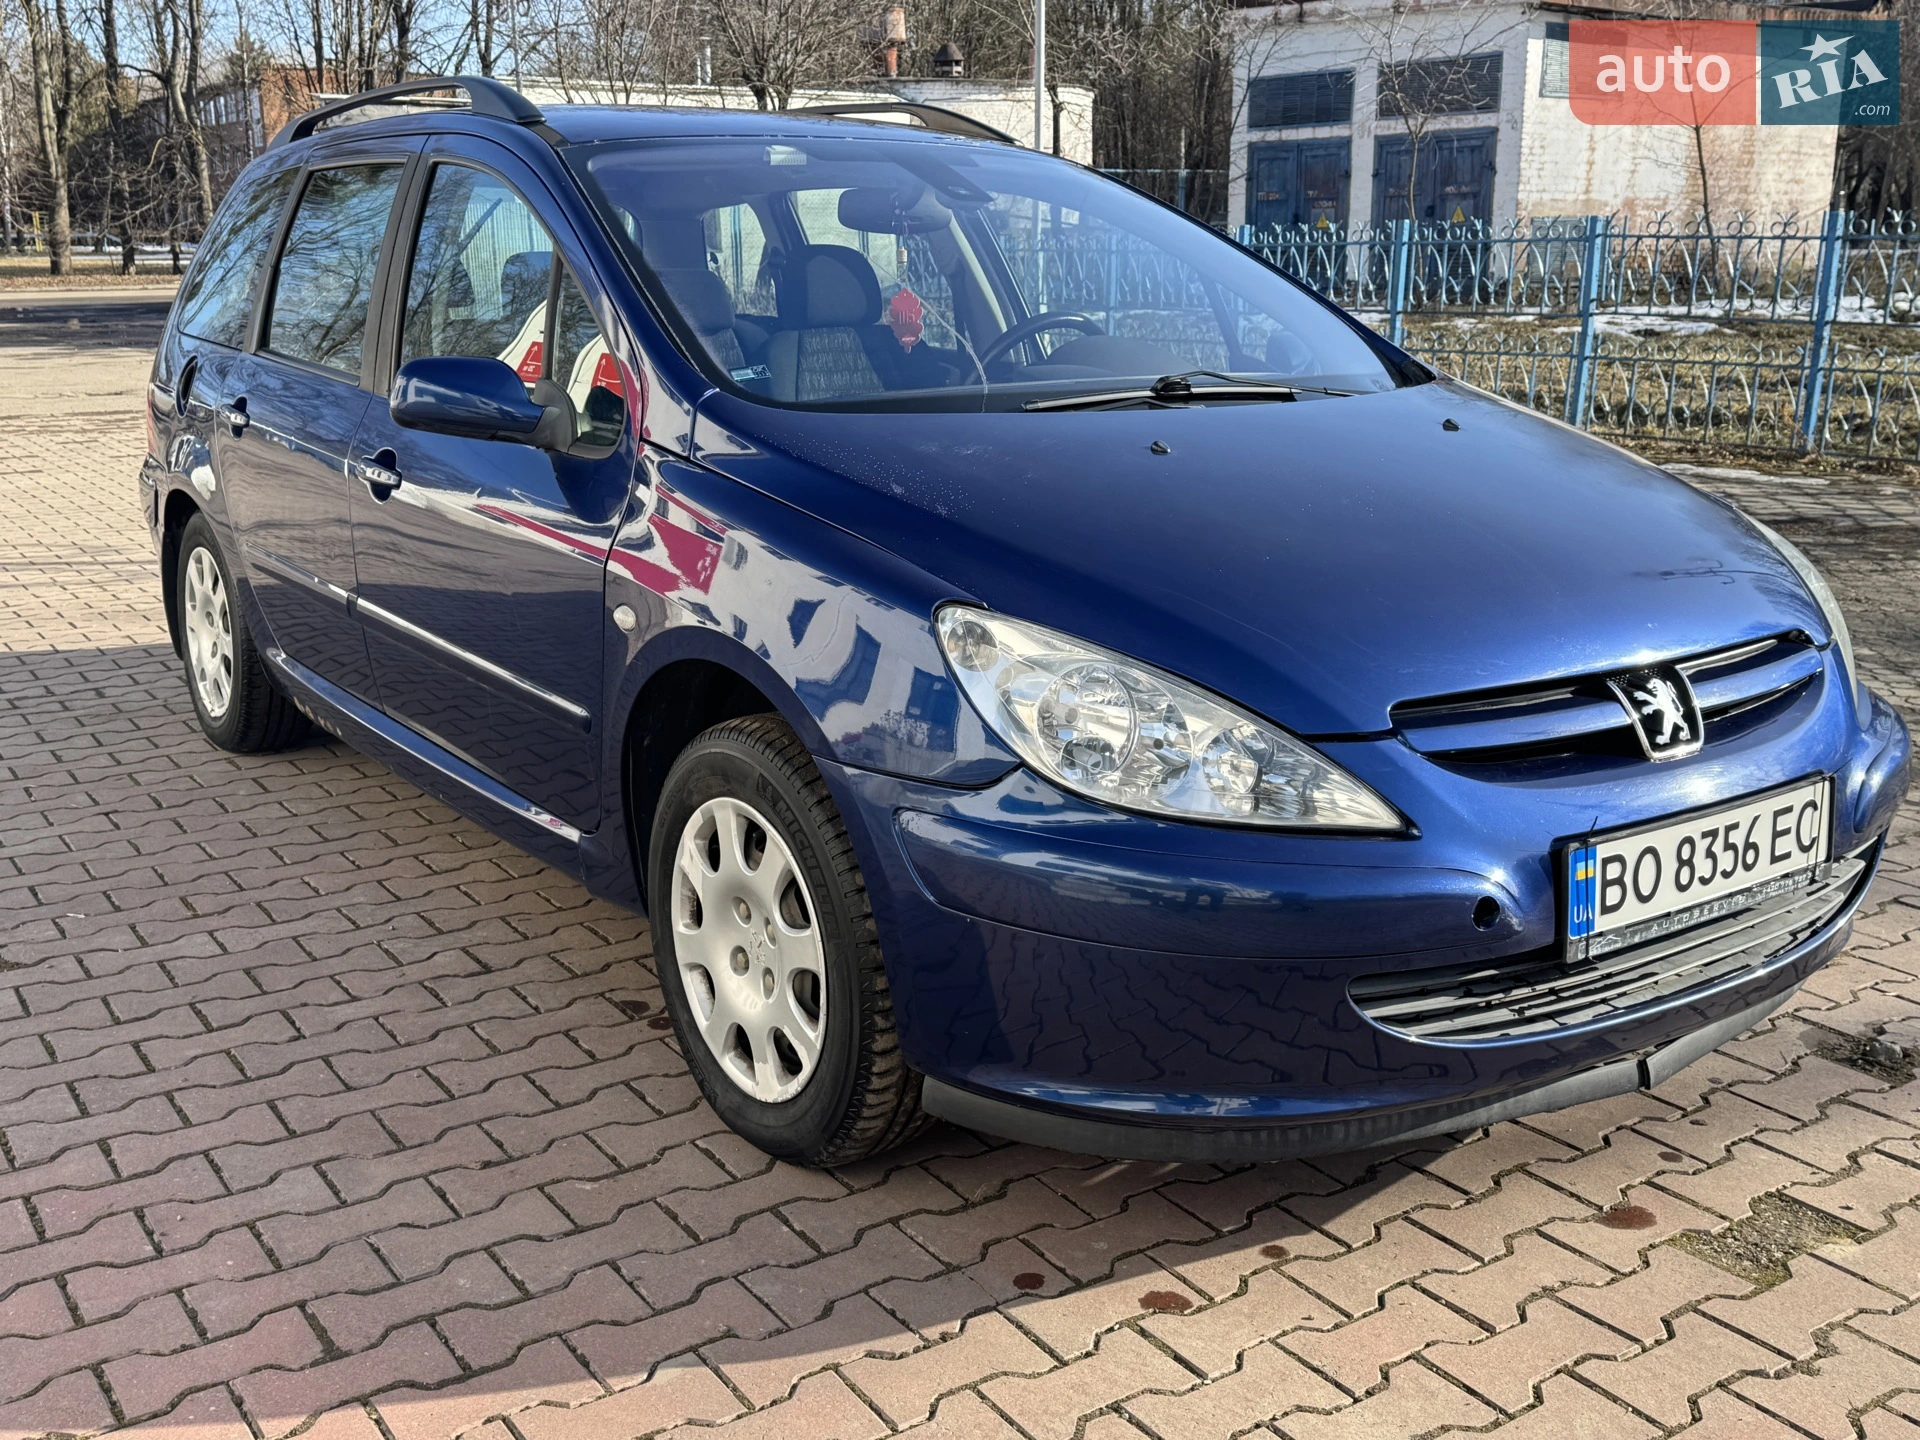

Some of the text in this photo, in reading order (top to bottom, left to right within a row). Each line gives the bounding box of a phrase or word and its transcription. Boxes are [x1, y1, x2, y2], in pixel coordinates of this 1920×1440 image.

[775, 802, 841, 943] MICHELIN
[1573, 905, 1594, 924] UA
[1600, 799, 1819, 916] BO 8356 EC
